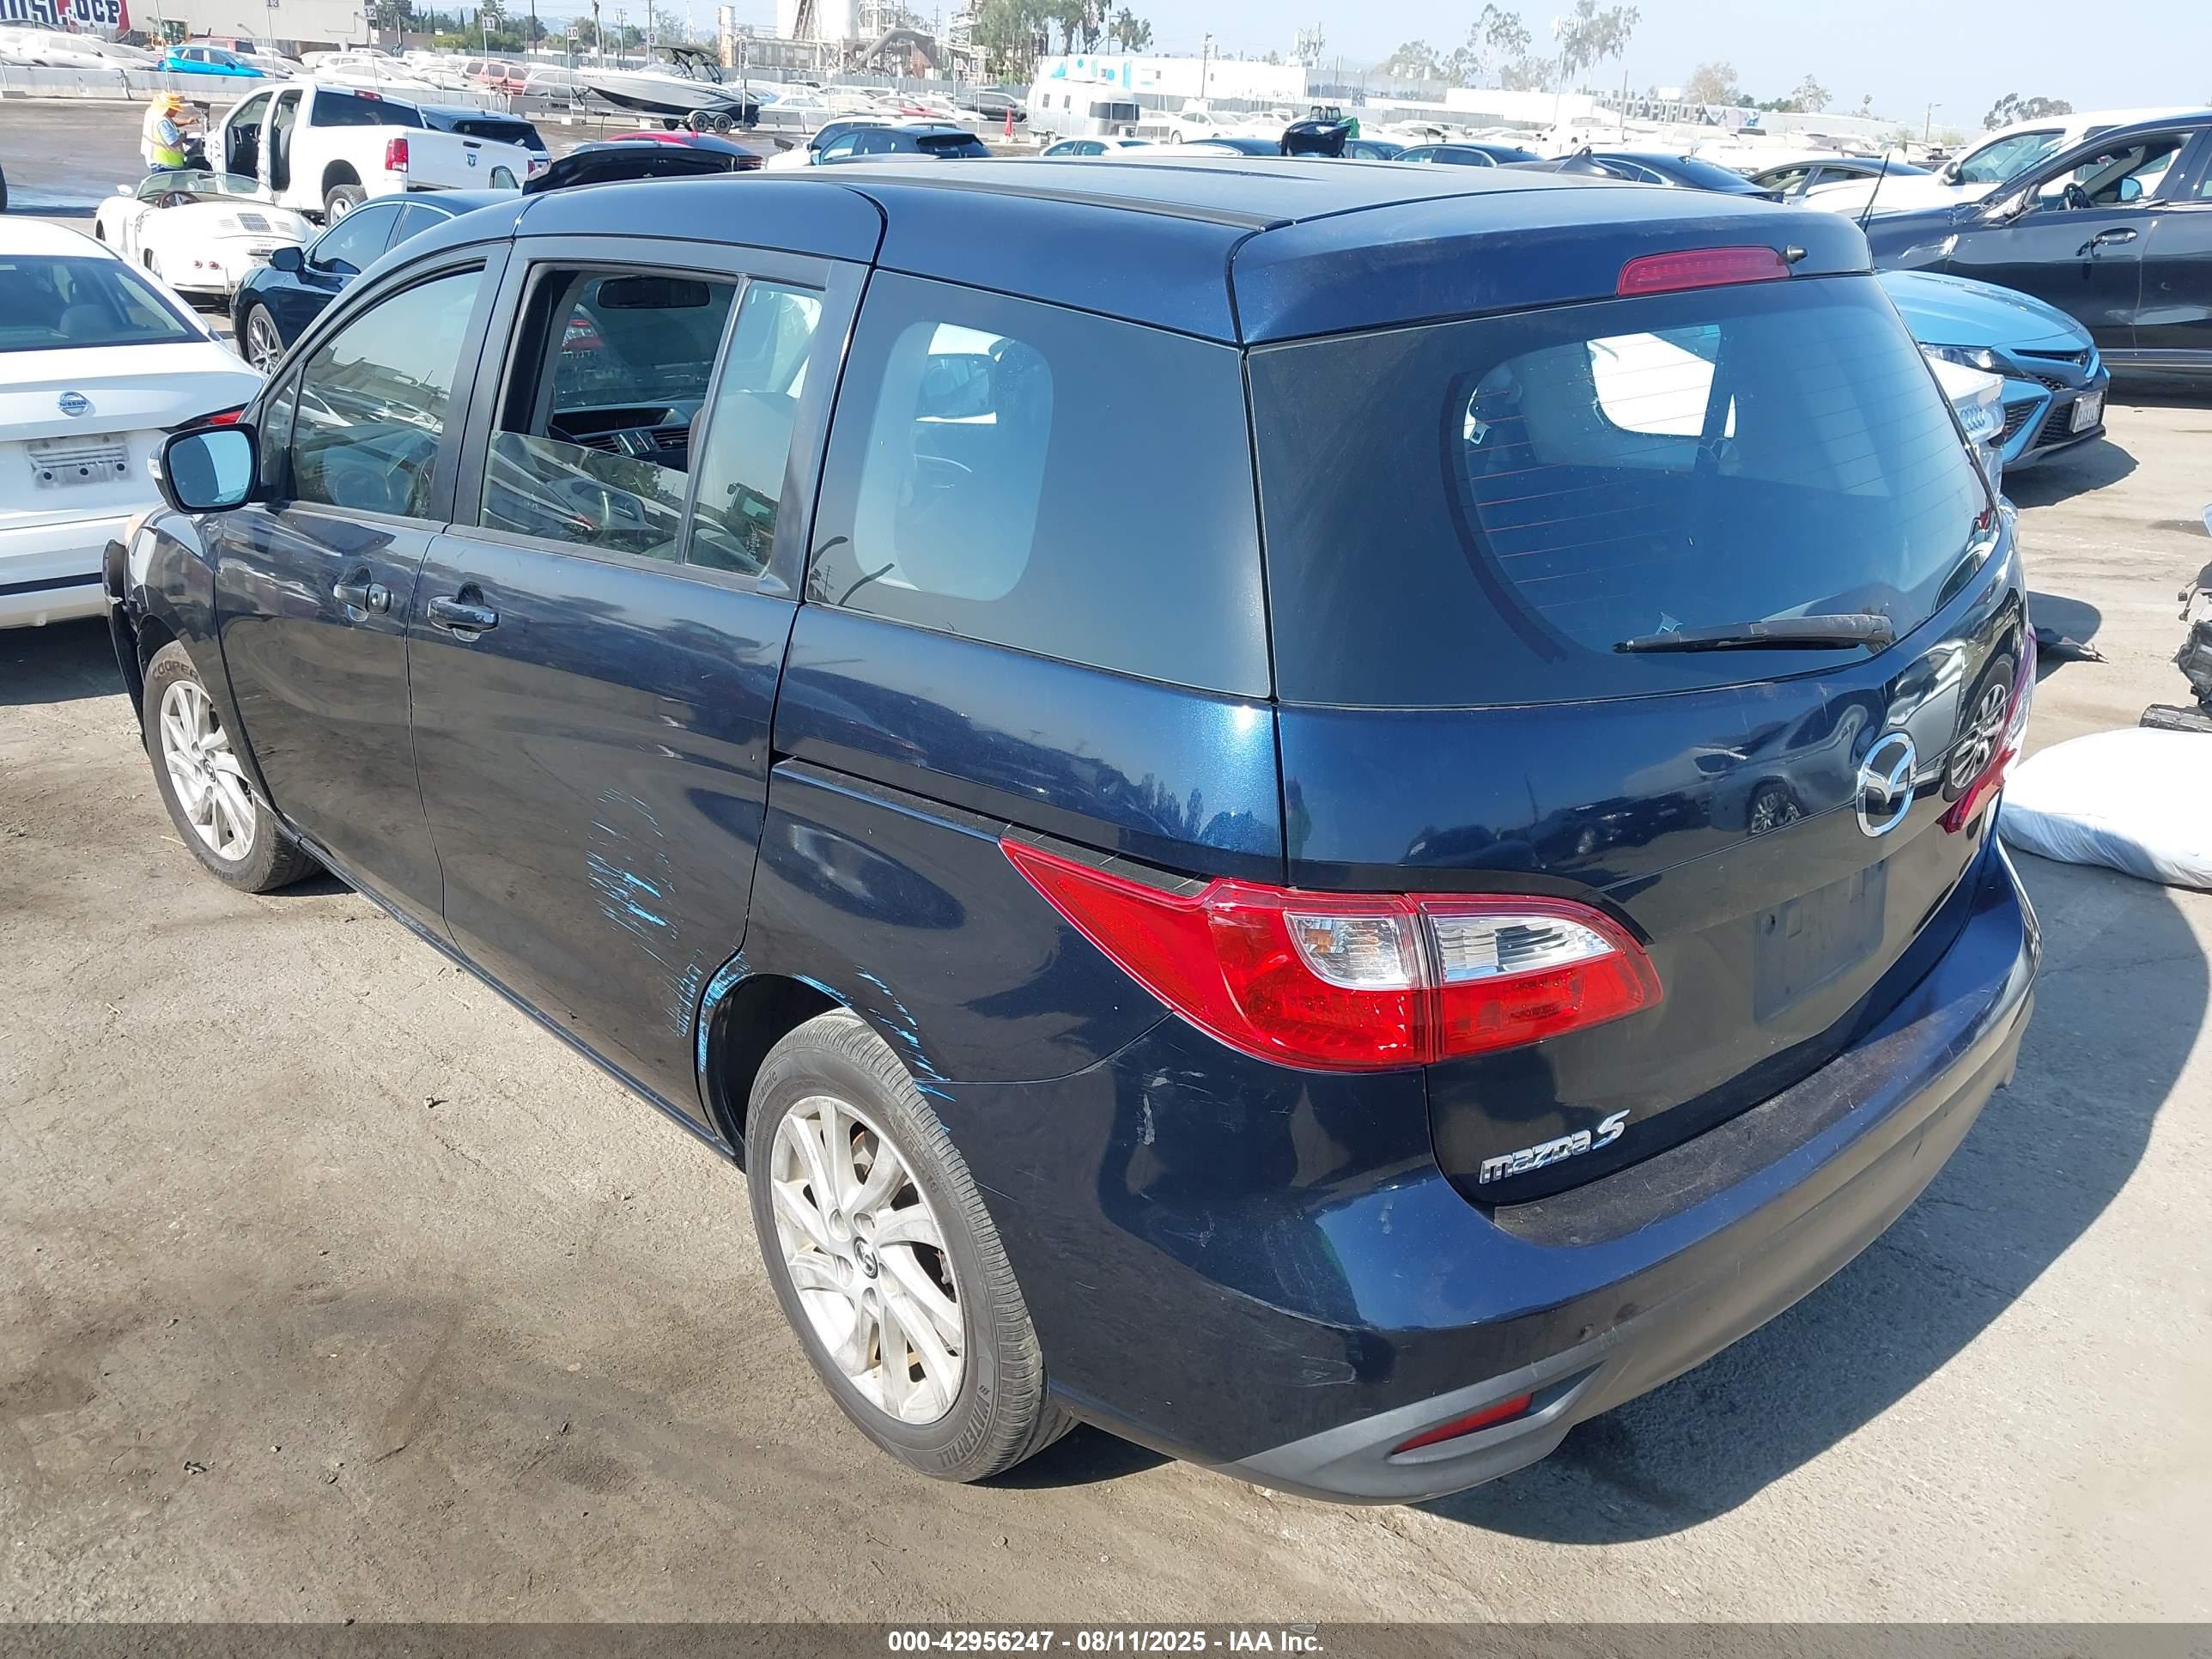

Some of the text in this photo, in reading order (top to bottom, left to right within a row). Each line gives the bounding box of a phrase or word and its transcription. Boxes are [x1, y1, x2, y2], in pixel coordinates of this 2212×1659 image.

[365, 9, 376, 17] 12
[483, 19, 495, 28] 11
[568, 28, 578, 37] 10
[649, 33, 655, 43] 9
